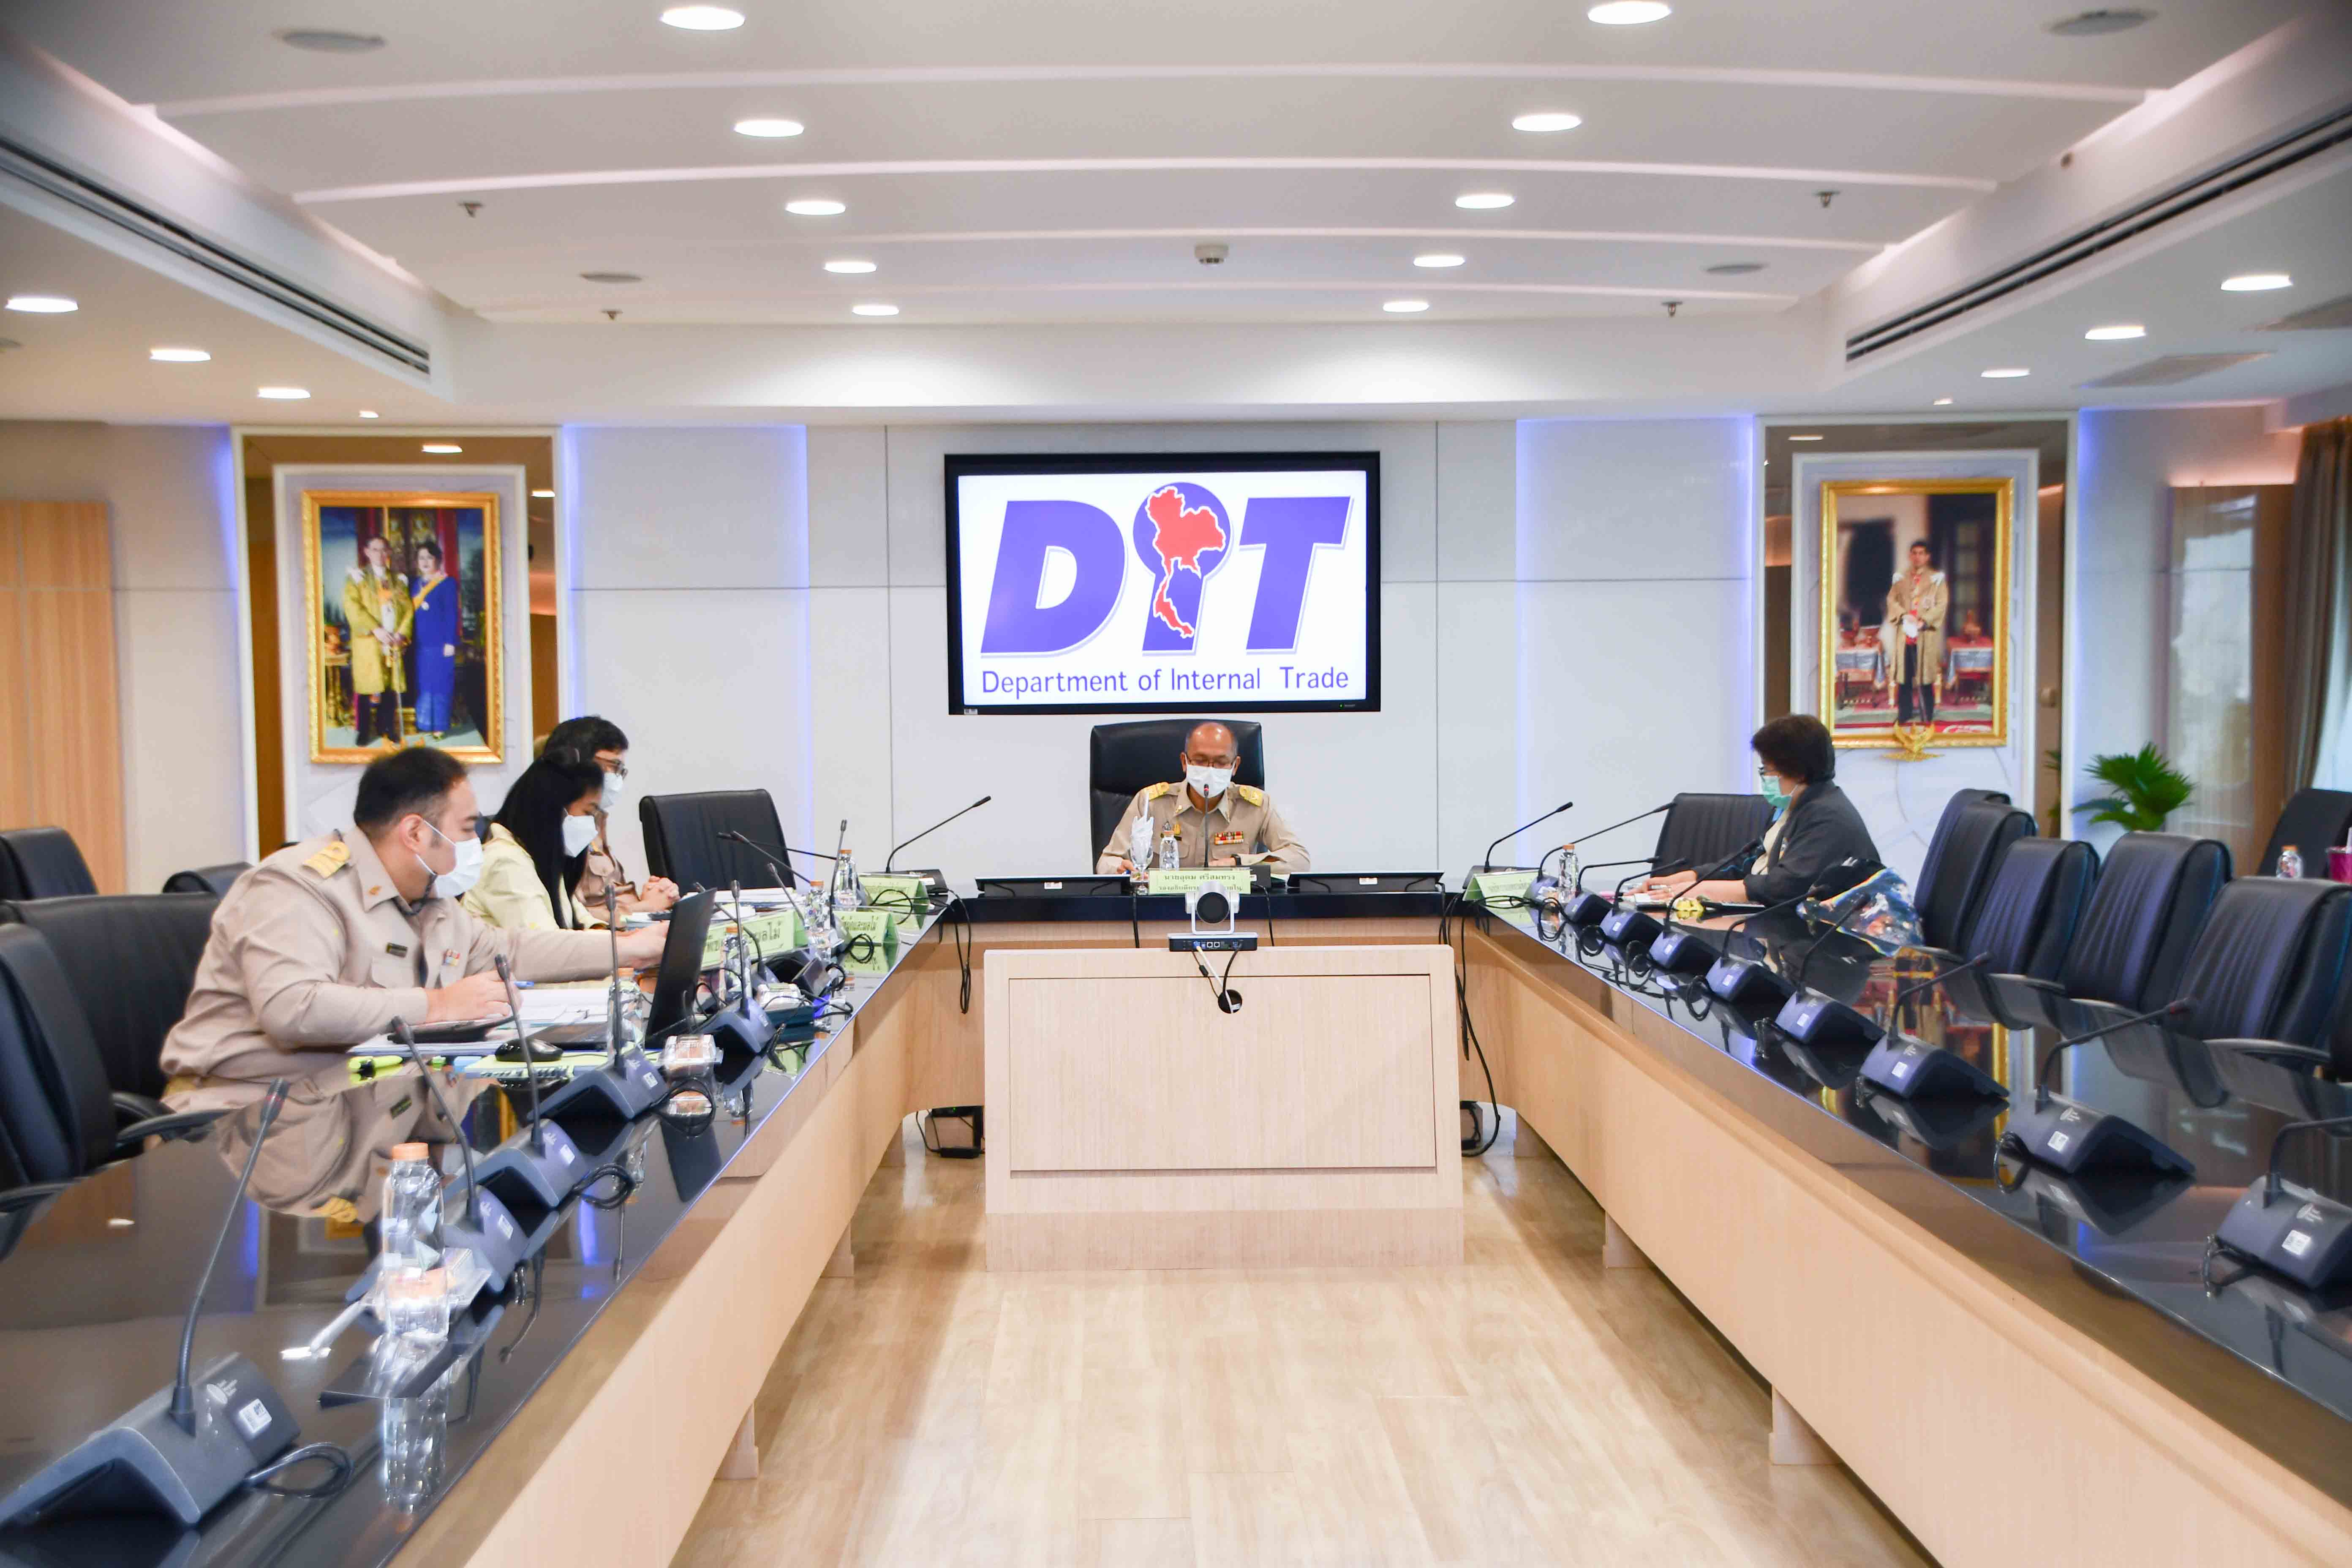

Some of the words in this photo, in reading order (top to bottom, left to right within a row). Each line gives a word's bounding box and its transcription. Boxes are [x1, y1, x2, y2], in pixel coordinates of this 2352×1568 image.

[983, 671, 1128, 700] Department
[1138, 668, 1162, 690] of
[1171, 667, 1260, 690] Internal
[1279, 666, 1349, 689] Trade
